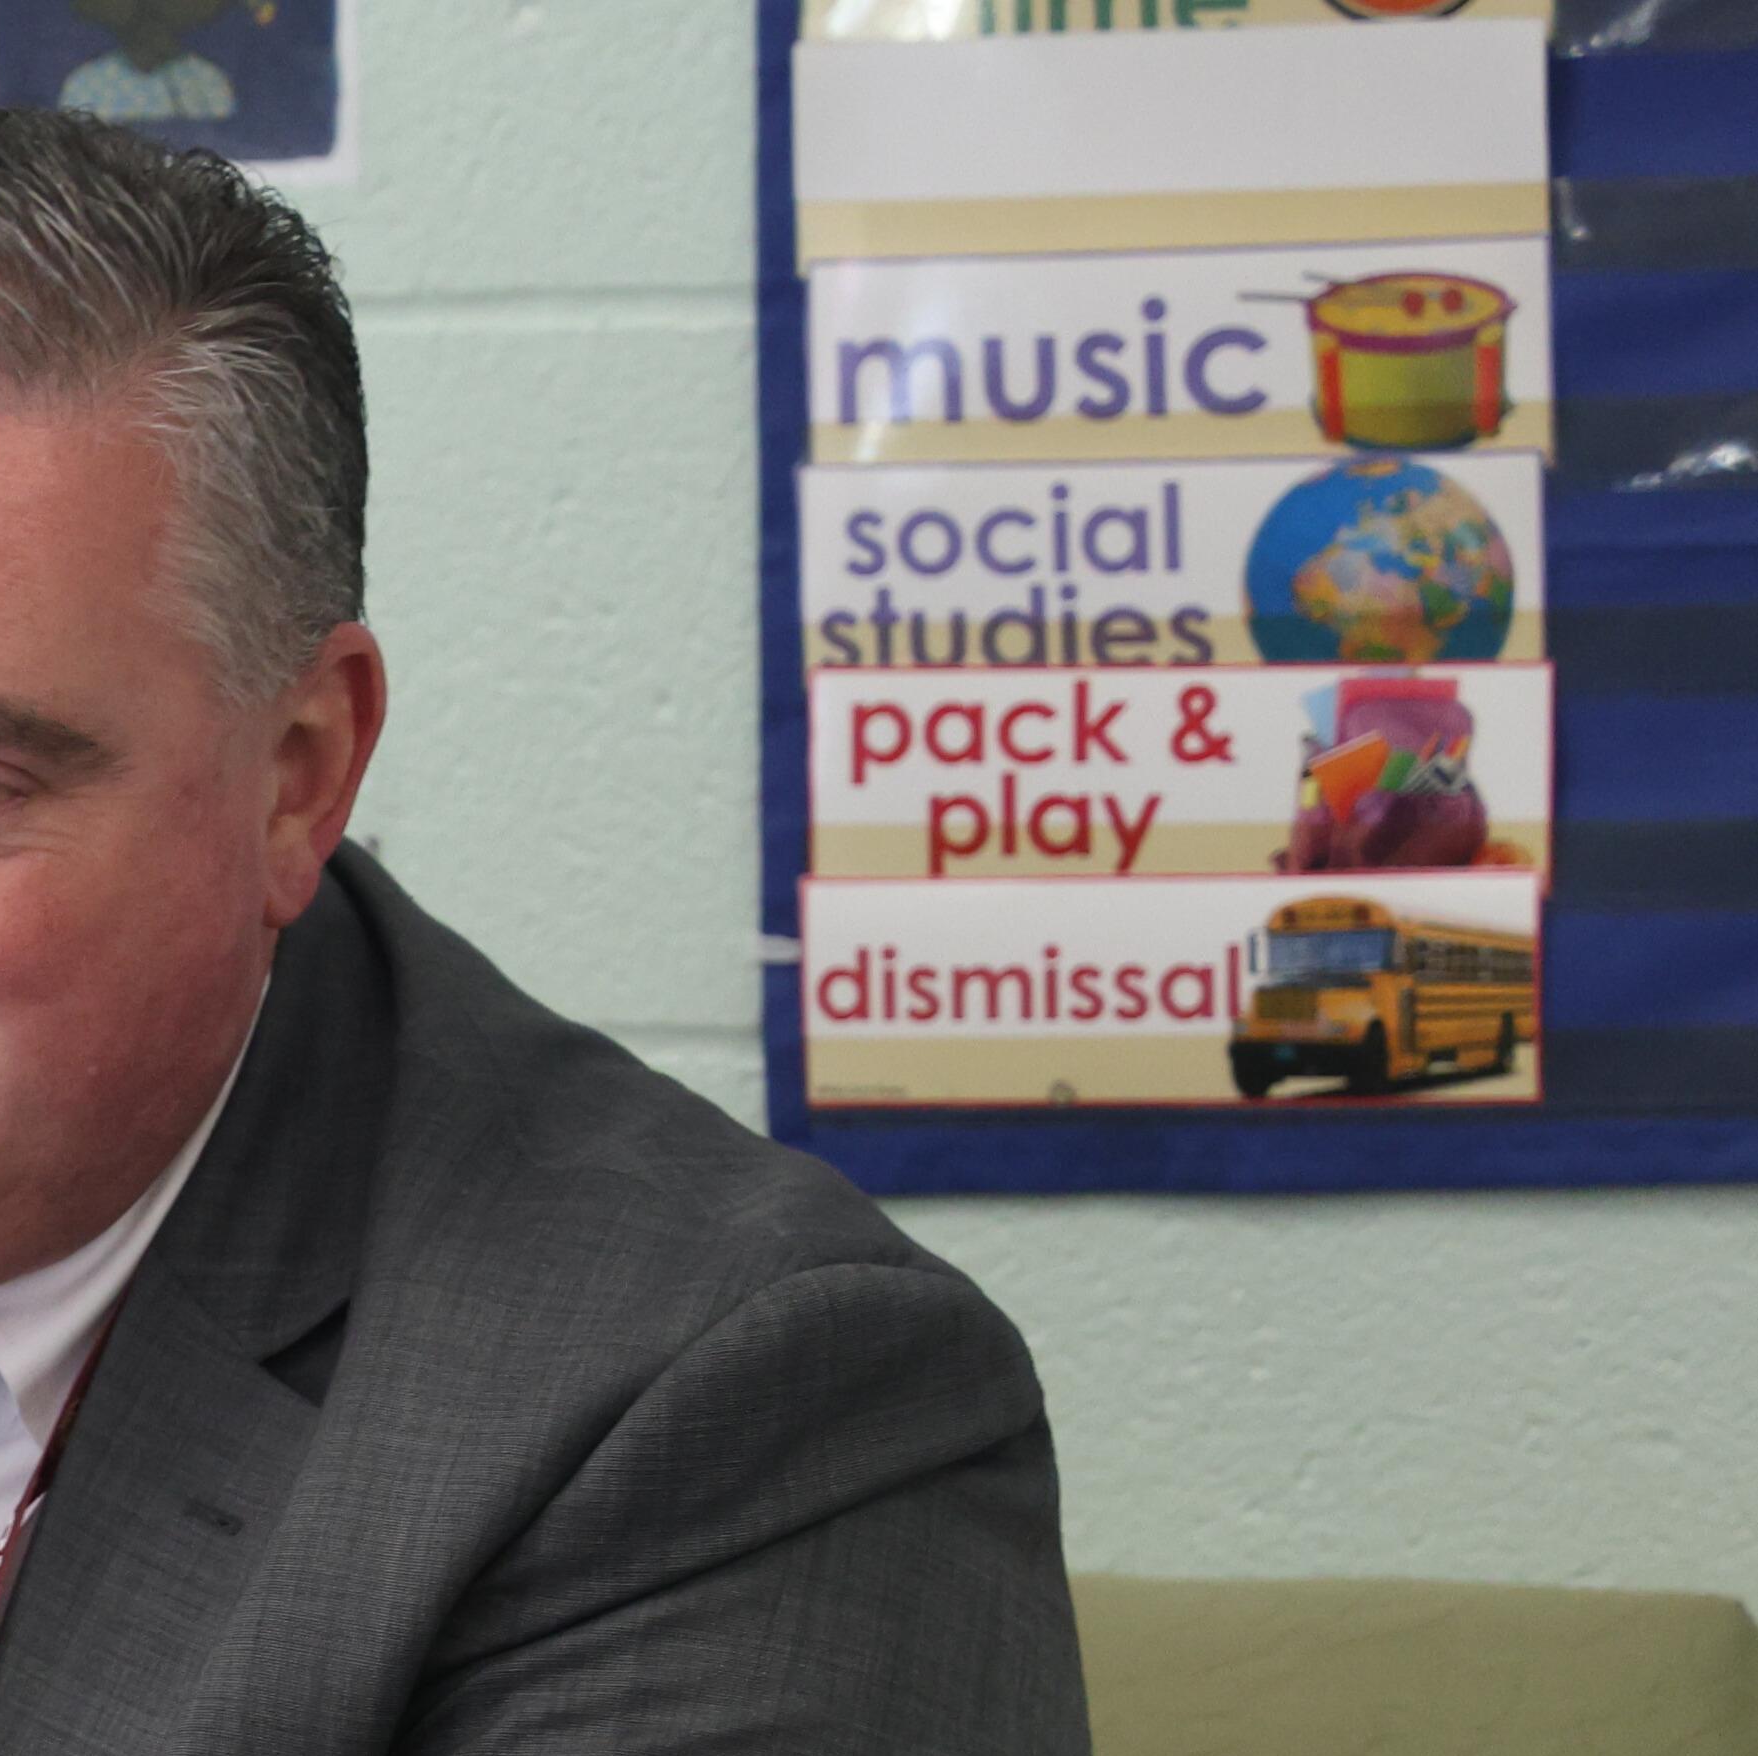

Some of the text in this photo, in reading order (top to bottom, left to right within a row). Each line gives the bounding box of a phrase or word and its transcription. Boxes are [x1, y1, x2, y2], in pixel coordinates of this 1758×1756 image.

[835, 296, 1269, 425] music
[844, 483, 1180, 577] social
[819, 586, 1215, 664] studies
[851, 680, 1234, 785] pack &
[927, 774, 1161, 876] play
[817, 945, 1242, 1023] dismissal
